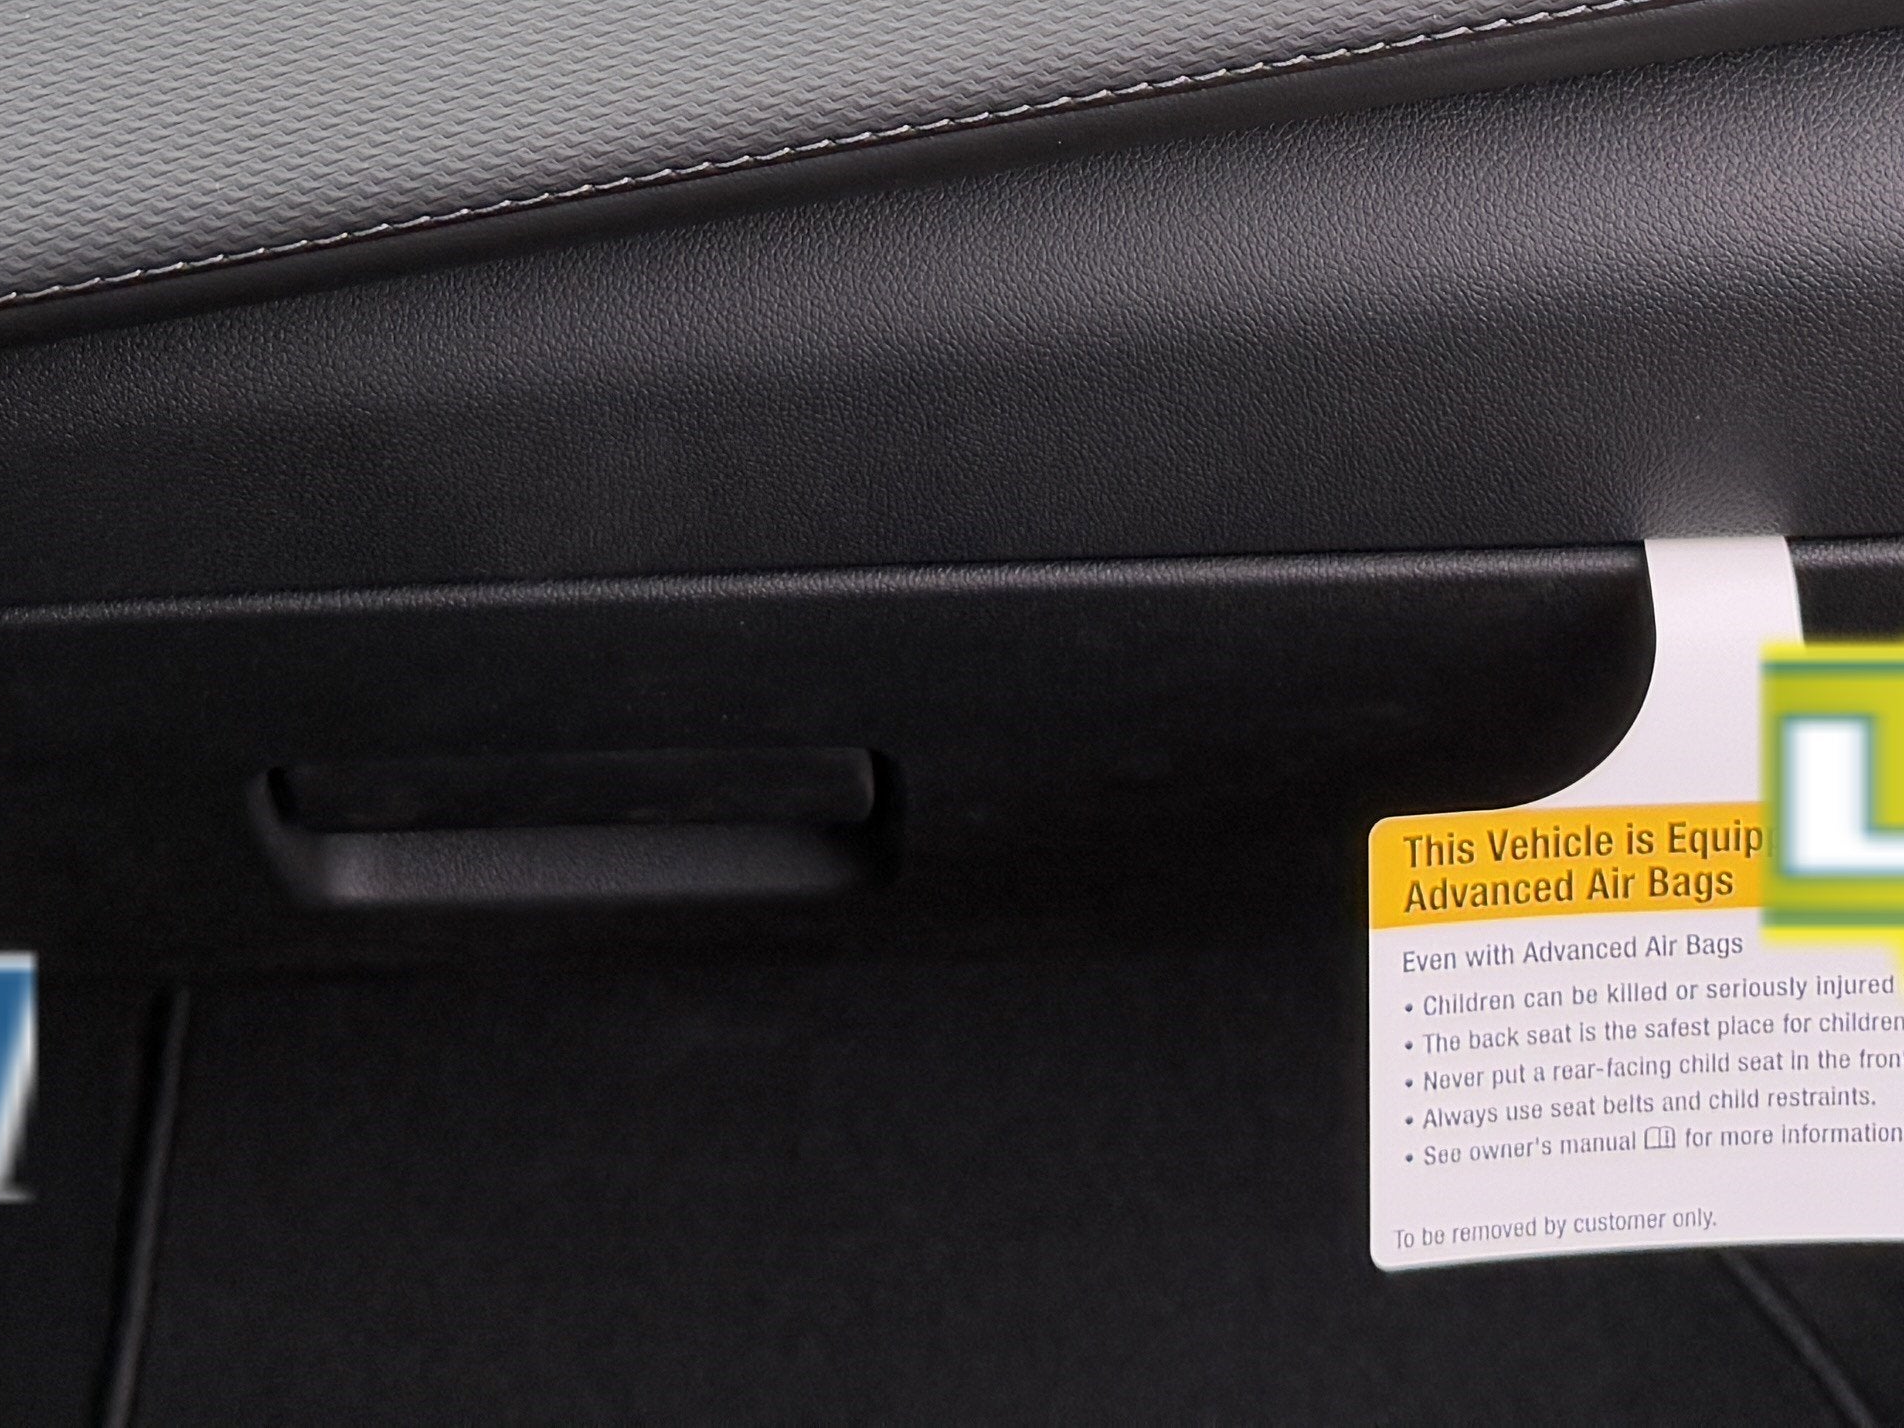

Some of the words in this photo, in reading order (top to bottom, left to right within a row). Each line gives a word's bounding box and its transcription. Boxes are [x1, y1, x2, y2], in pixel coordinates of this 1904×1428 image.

[1404, 832, 1475, 868] This
[1487, 824, 1613, 862] Vehicle
[1627, 822, 1655, 856] is
[1404, 869, 1574, 913] Advanced
[1587, 866, 1635, 901] Air
[1649, 866, 1734, 904] Bags
[1403, 950, 1456, 973] Even
[1466, 944, 1514, 967] with
[1523, 936, 1636, 963] Advanced
[1646, 933, 1678, 957] Air
[1686, 933, 1744, 959] Bags
[1423, 989, 1515, 1016] Children
[1524, 988, 1563, 1008] can
[1572, 984, 1598, 1005] be
[1607, 981, 1667, 1002] killed
[1675, 985, 1696, 1001] or
[1706, 976, 1807, 1000] seriously
[1816, 975, 1895, 1000] injured
[1423, 1033, 1460, 1054] The
[1469, 1028, 1520, 1050] back
[1527, 1024, 1571, 1045] seat
[1579, 1022, 1596, 1042] is
[1605, 1020, 1637, 1040] the
[1645, 1017, 1710, 1039] safest
[1717, 1014, 1774, 1039] place
[1783, 1013, 1812, 1034] for
[1423, 1071, 1484, 1091] Never
[1492, 1064, 1526, 1089] put
[1533, 1066, 1545, 1082] a
[1553, 1055, 1671, 1081] rear-facing
[1679, 1052, 1730, 1074] child
[1738, 1052, 1784, 1072] seat
[1791, 1050, 1810, 1070] in
[1818, 1049, 1851, 1069] the
[1423, 1107, 1498, 1129] Always
[1506, 1103, 1543, 1122] use
[1551, 1097, 1596, 1118] seat
[1603, 1093, 1654, 1115] belts
[1662, 1090, 1701, 1112] and
[1709, 1089, 1759, 1110] child
[1767, 1086, 1877, 1109] restraints.
[1423, 1145, 1462, 1165] See
[1469, 1137, 1552, 1162] owner's
[1560, 1132, 1636, 1155] manual
[1685, 1126, 1713, 1148] for
[1721, 1128, 1774, 1146] more
[1782, 1123, 1904, 1145] information
[1394, 1228, 1414, 1248] To
[1422, 1224, 1445, 1246] be
[1452, 1216, 1536, 1244] removed
[1544, 1214, 1567, 1239] by
[1574, 1210, 1667, 1233] customer
[1673, 1208, 1718, 1231] only.
